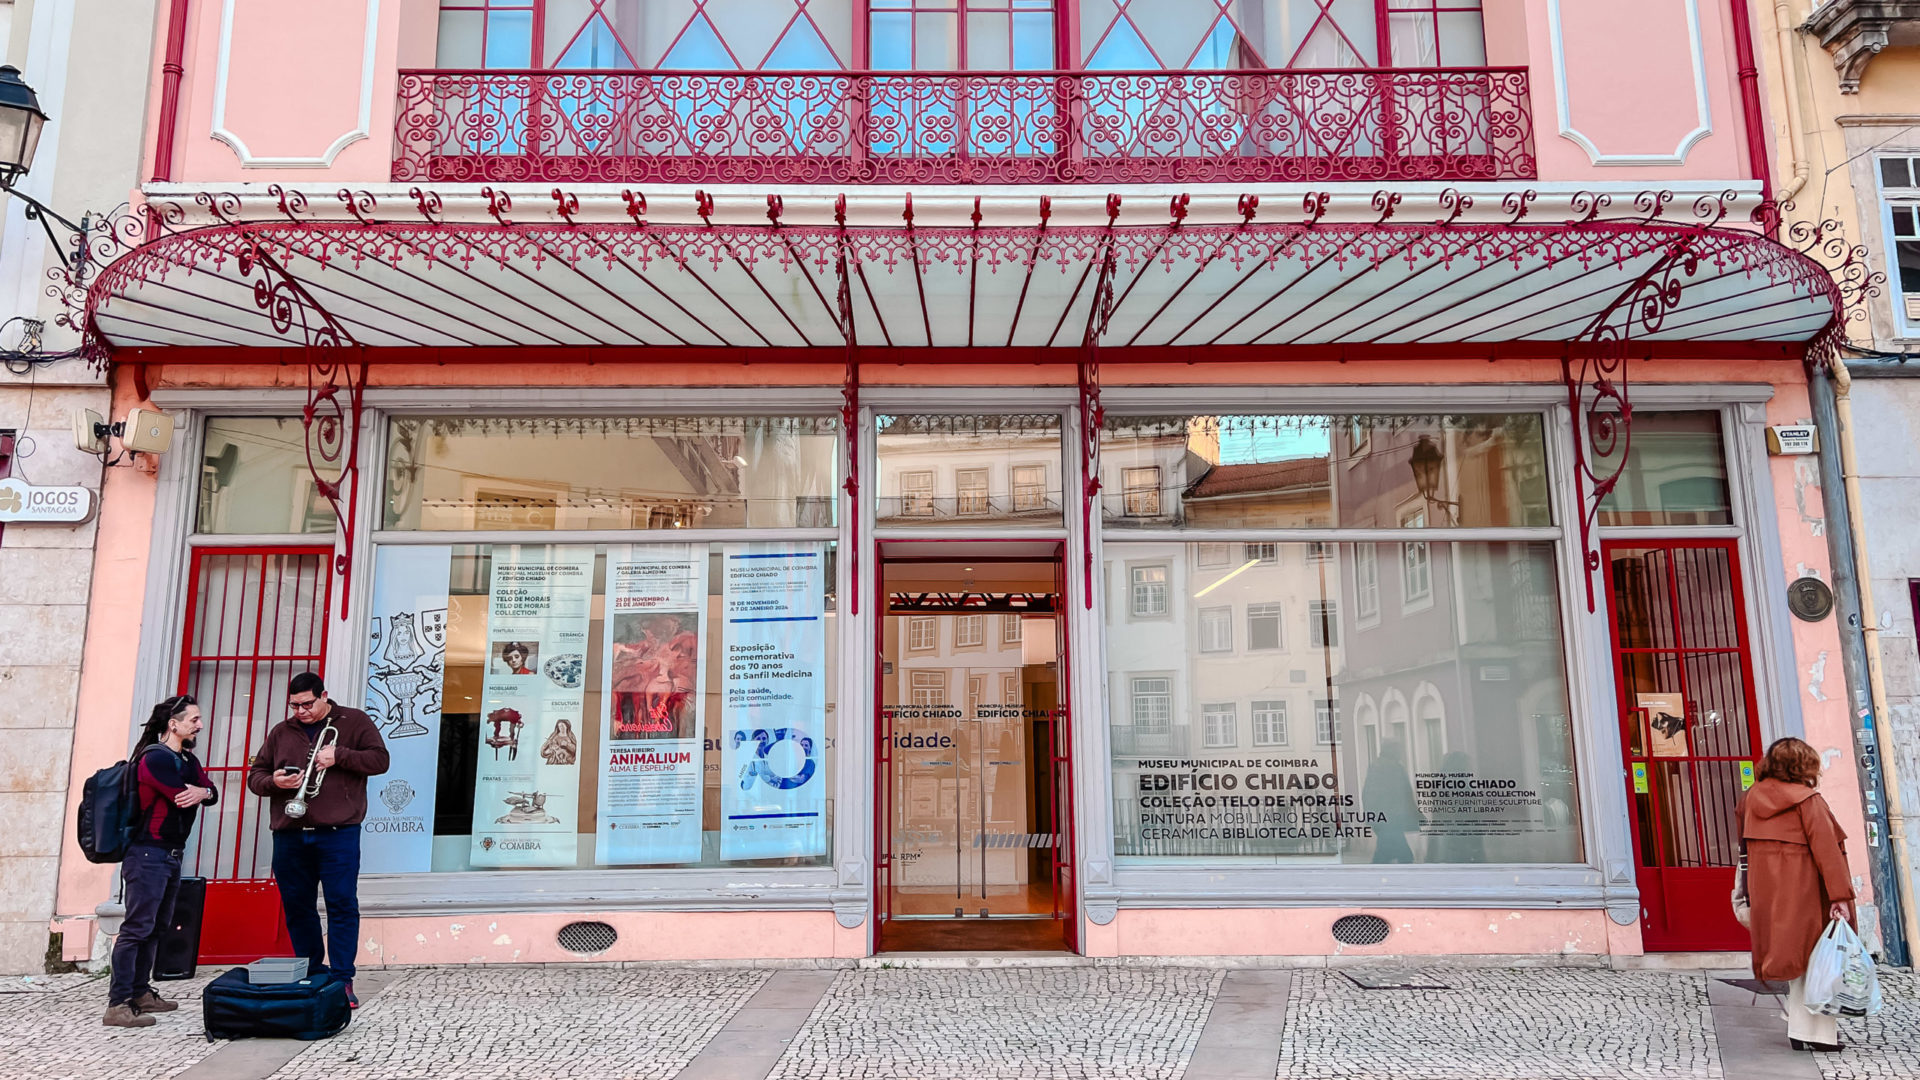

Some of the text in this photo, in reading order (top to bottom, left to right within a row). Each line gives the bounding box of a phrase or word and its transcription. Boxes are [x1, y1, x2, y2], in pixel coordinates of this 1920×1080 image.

[26, 491, 78, 509] JOGOS
[730, 644, 775, 653] Exposição
[730, 652, 794, 661] comemorativa
[772, 670, 812, 678] Medicina
[977, 708, 1019, 718] EDIFÍCIO
[610, 752, 690, 765] ANIMALIUM
[1265, 760, 1318, 768] COIMBRA
[1140, 769, 1338, 791] EDIFÍCIO CHIADO
[1416, 778, 1516, 789] EDIFÍCIO CHIADO
[1140, 793, 1353, 811] COLEÇÃO TELO DE MORAIS
[1141, 810, 1387, 824] PINTURA MOBILIÁRIO ESCULTURA
[364, 822, 424, 833] COIMBRA
[1223, 827, 1307, 838] BIBLIOTECA
[1311, 827, 1329, 838] DE
[1334, 826, 1372, 838] ARTE
[500, 842, 541, 850] COIMBRA
